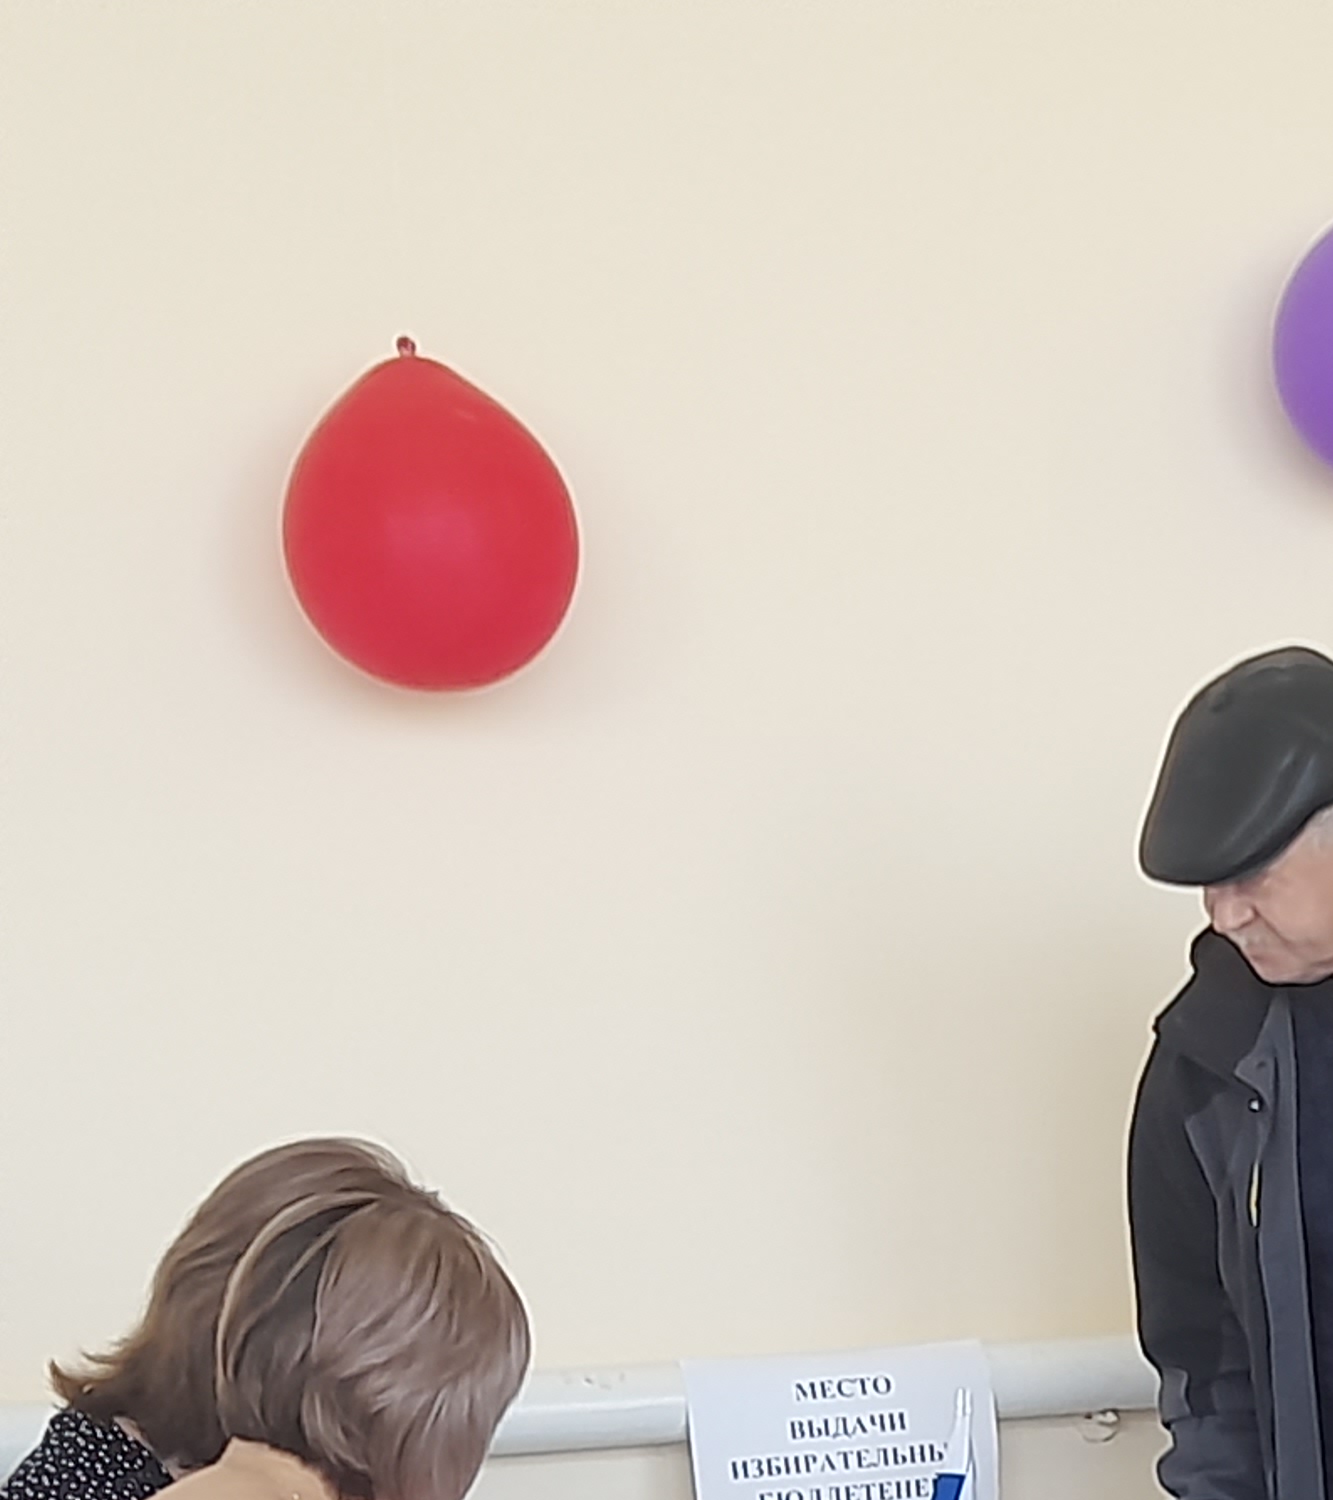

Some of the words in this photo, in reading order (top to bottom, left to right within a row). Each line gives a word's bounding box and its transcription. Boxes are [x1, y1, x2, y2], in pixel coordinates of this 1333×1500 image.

[795, 1375, 892, 1401] МЕСТО
[790, 1412, 906, 1439] ВЫДАЧИ
[731, 1442, 948, 1480] ИЗБИРАТЕЛЬНЫ
